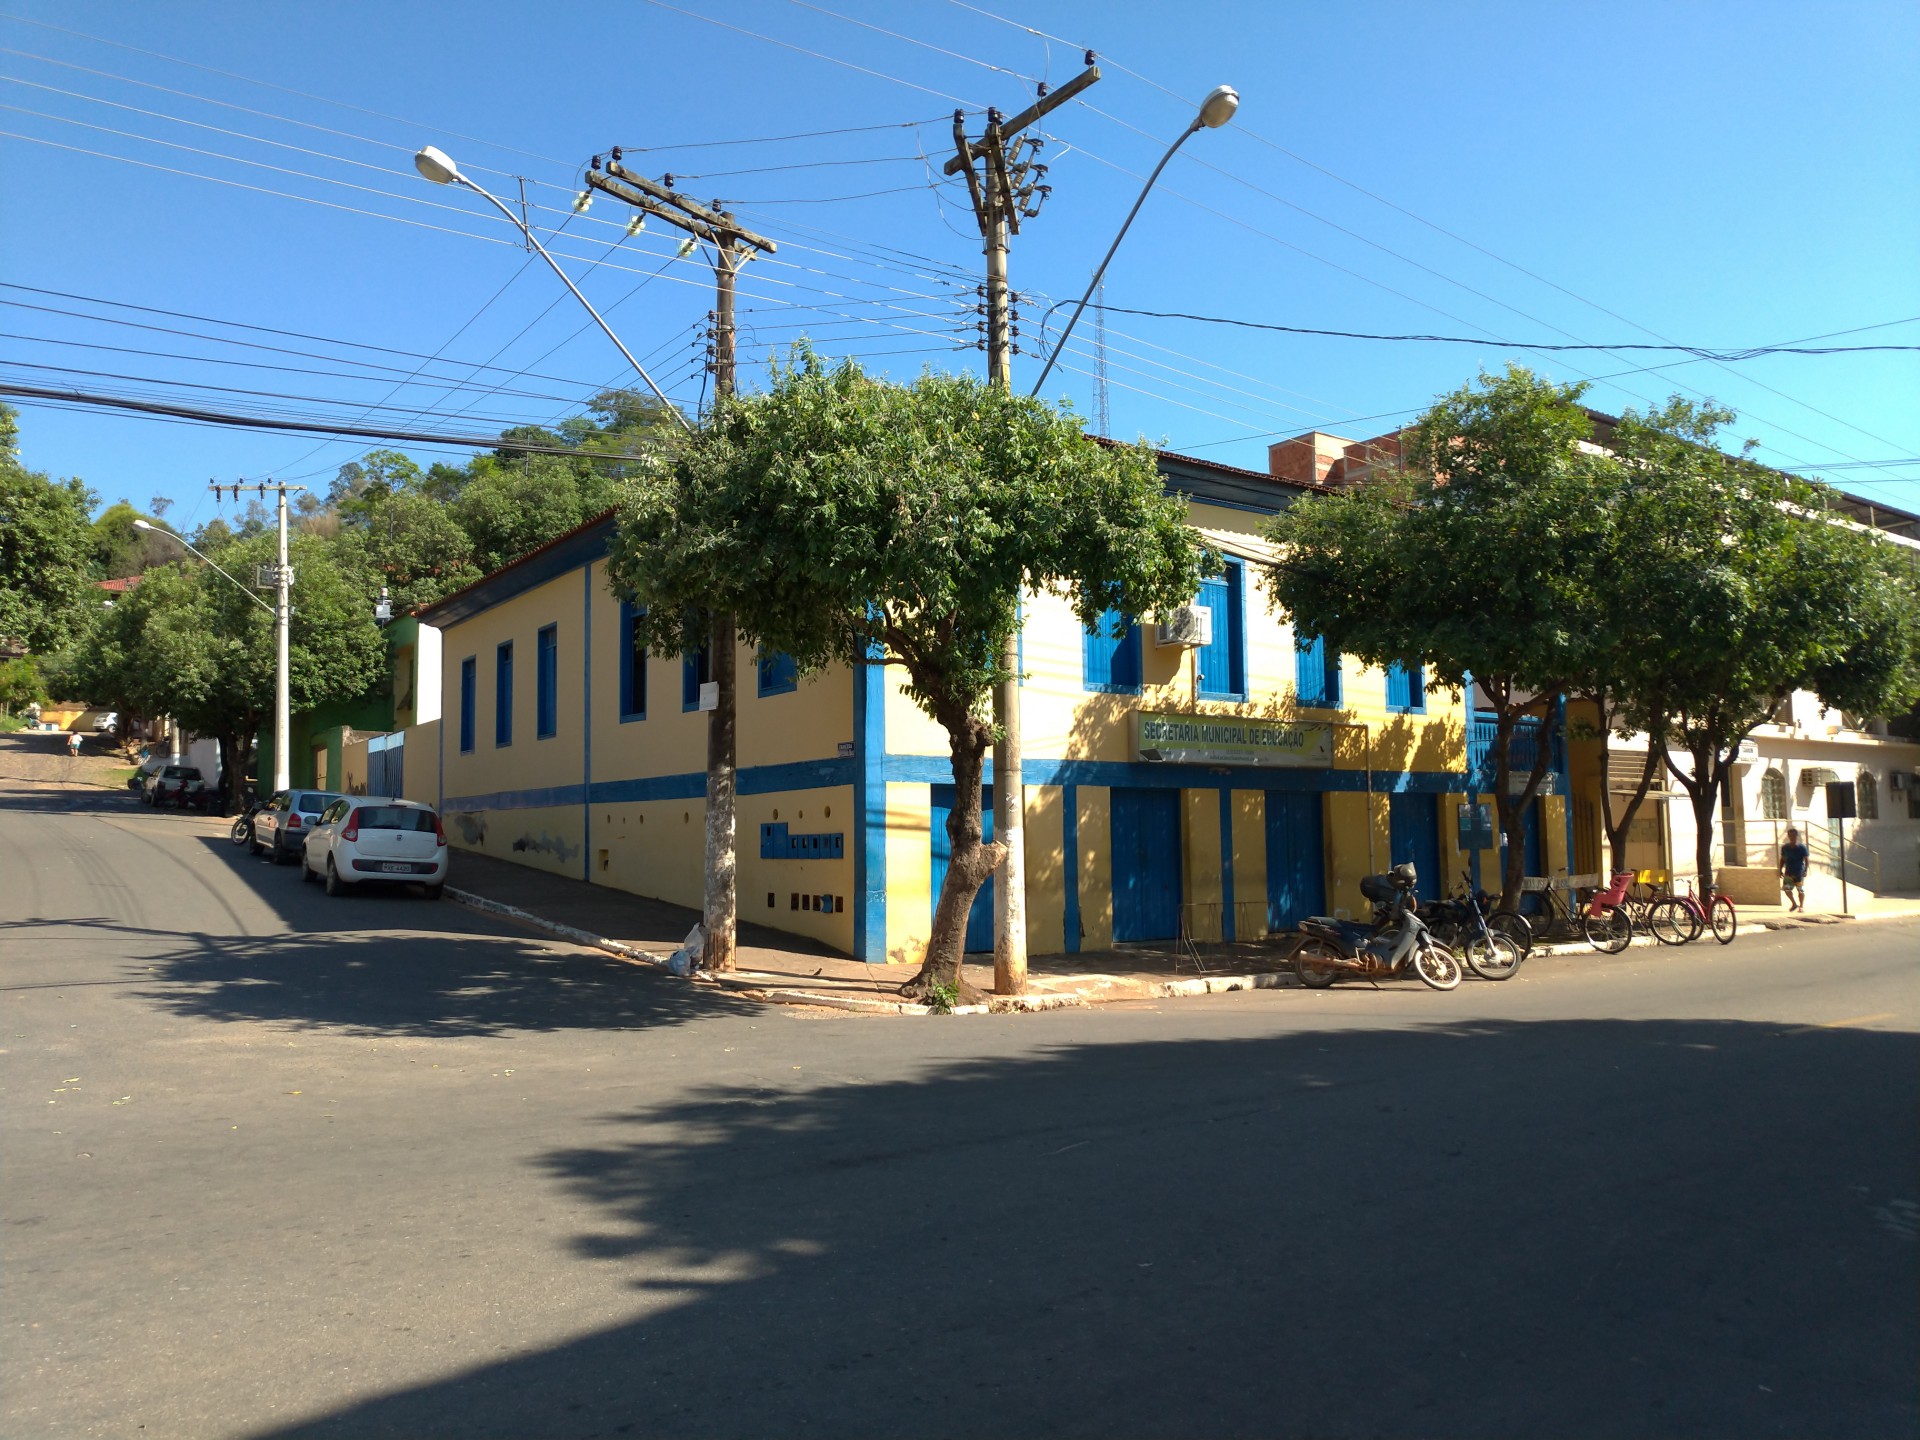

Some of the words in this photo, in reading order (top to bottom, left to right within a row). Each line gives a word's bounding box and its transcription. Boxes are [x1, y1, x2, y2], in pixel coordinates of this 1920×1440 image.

[1144, 721, 1199, 742] SECRETARIA
[1201, 725, 1247, 745] MUNICIPAL
[1249, 728, 1260, 746] DE
[1262, 727, 1304, 749] EDUCAÇÃO
